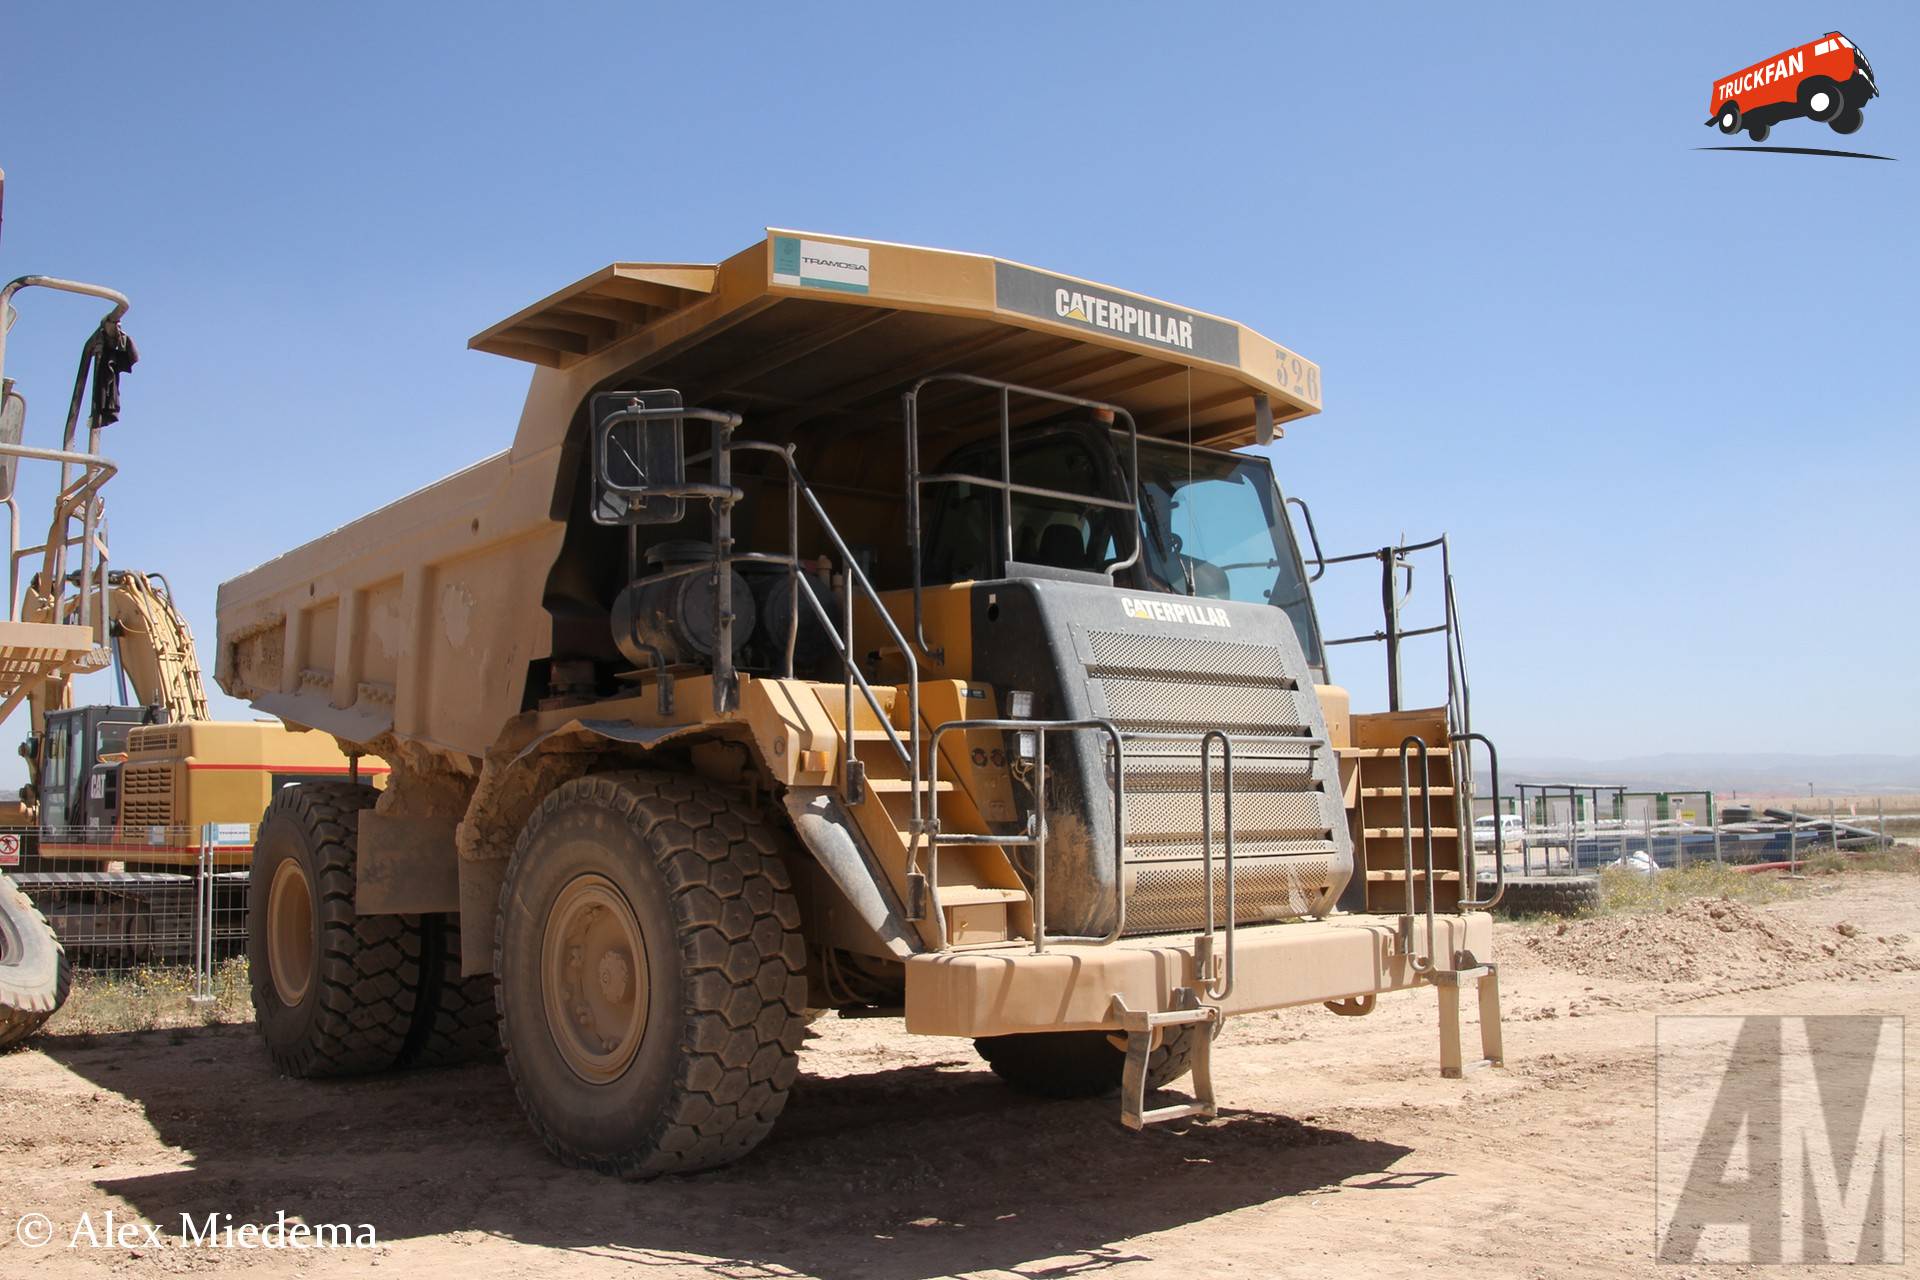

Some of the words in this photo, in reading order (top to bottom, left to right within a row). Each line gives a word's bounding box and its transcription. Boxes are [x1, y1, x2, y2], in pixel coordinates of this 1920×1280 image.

[801, 256, 868, 272] TRAMOSA
[1055, 288, 1193, 350] CATERPILLAR
[1275, 349, 1319, 401] 326
[1121, 597, 1232, 628] CATERPILLAR
[91, 773, 106, 799] CAT
